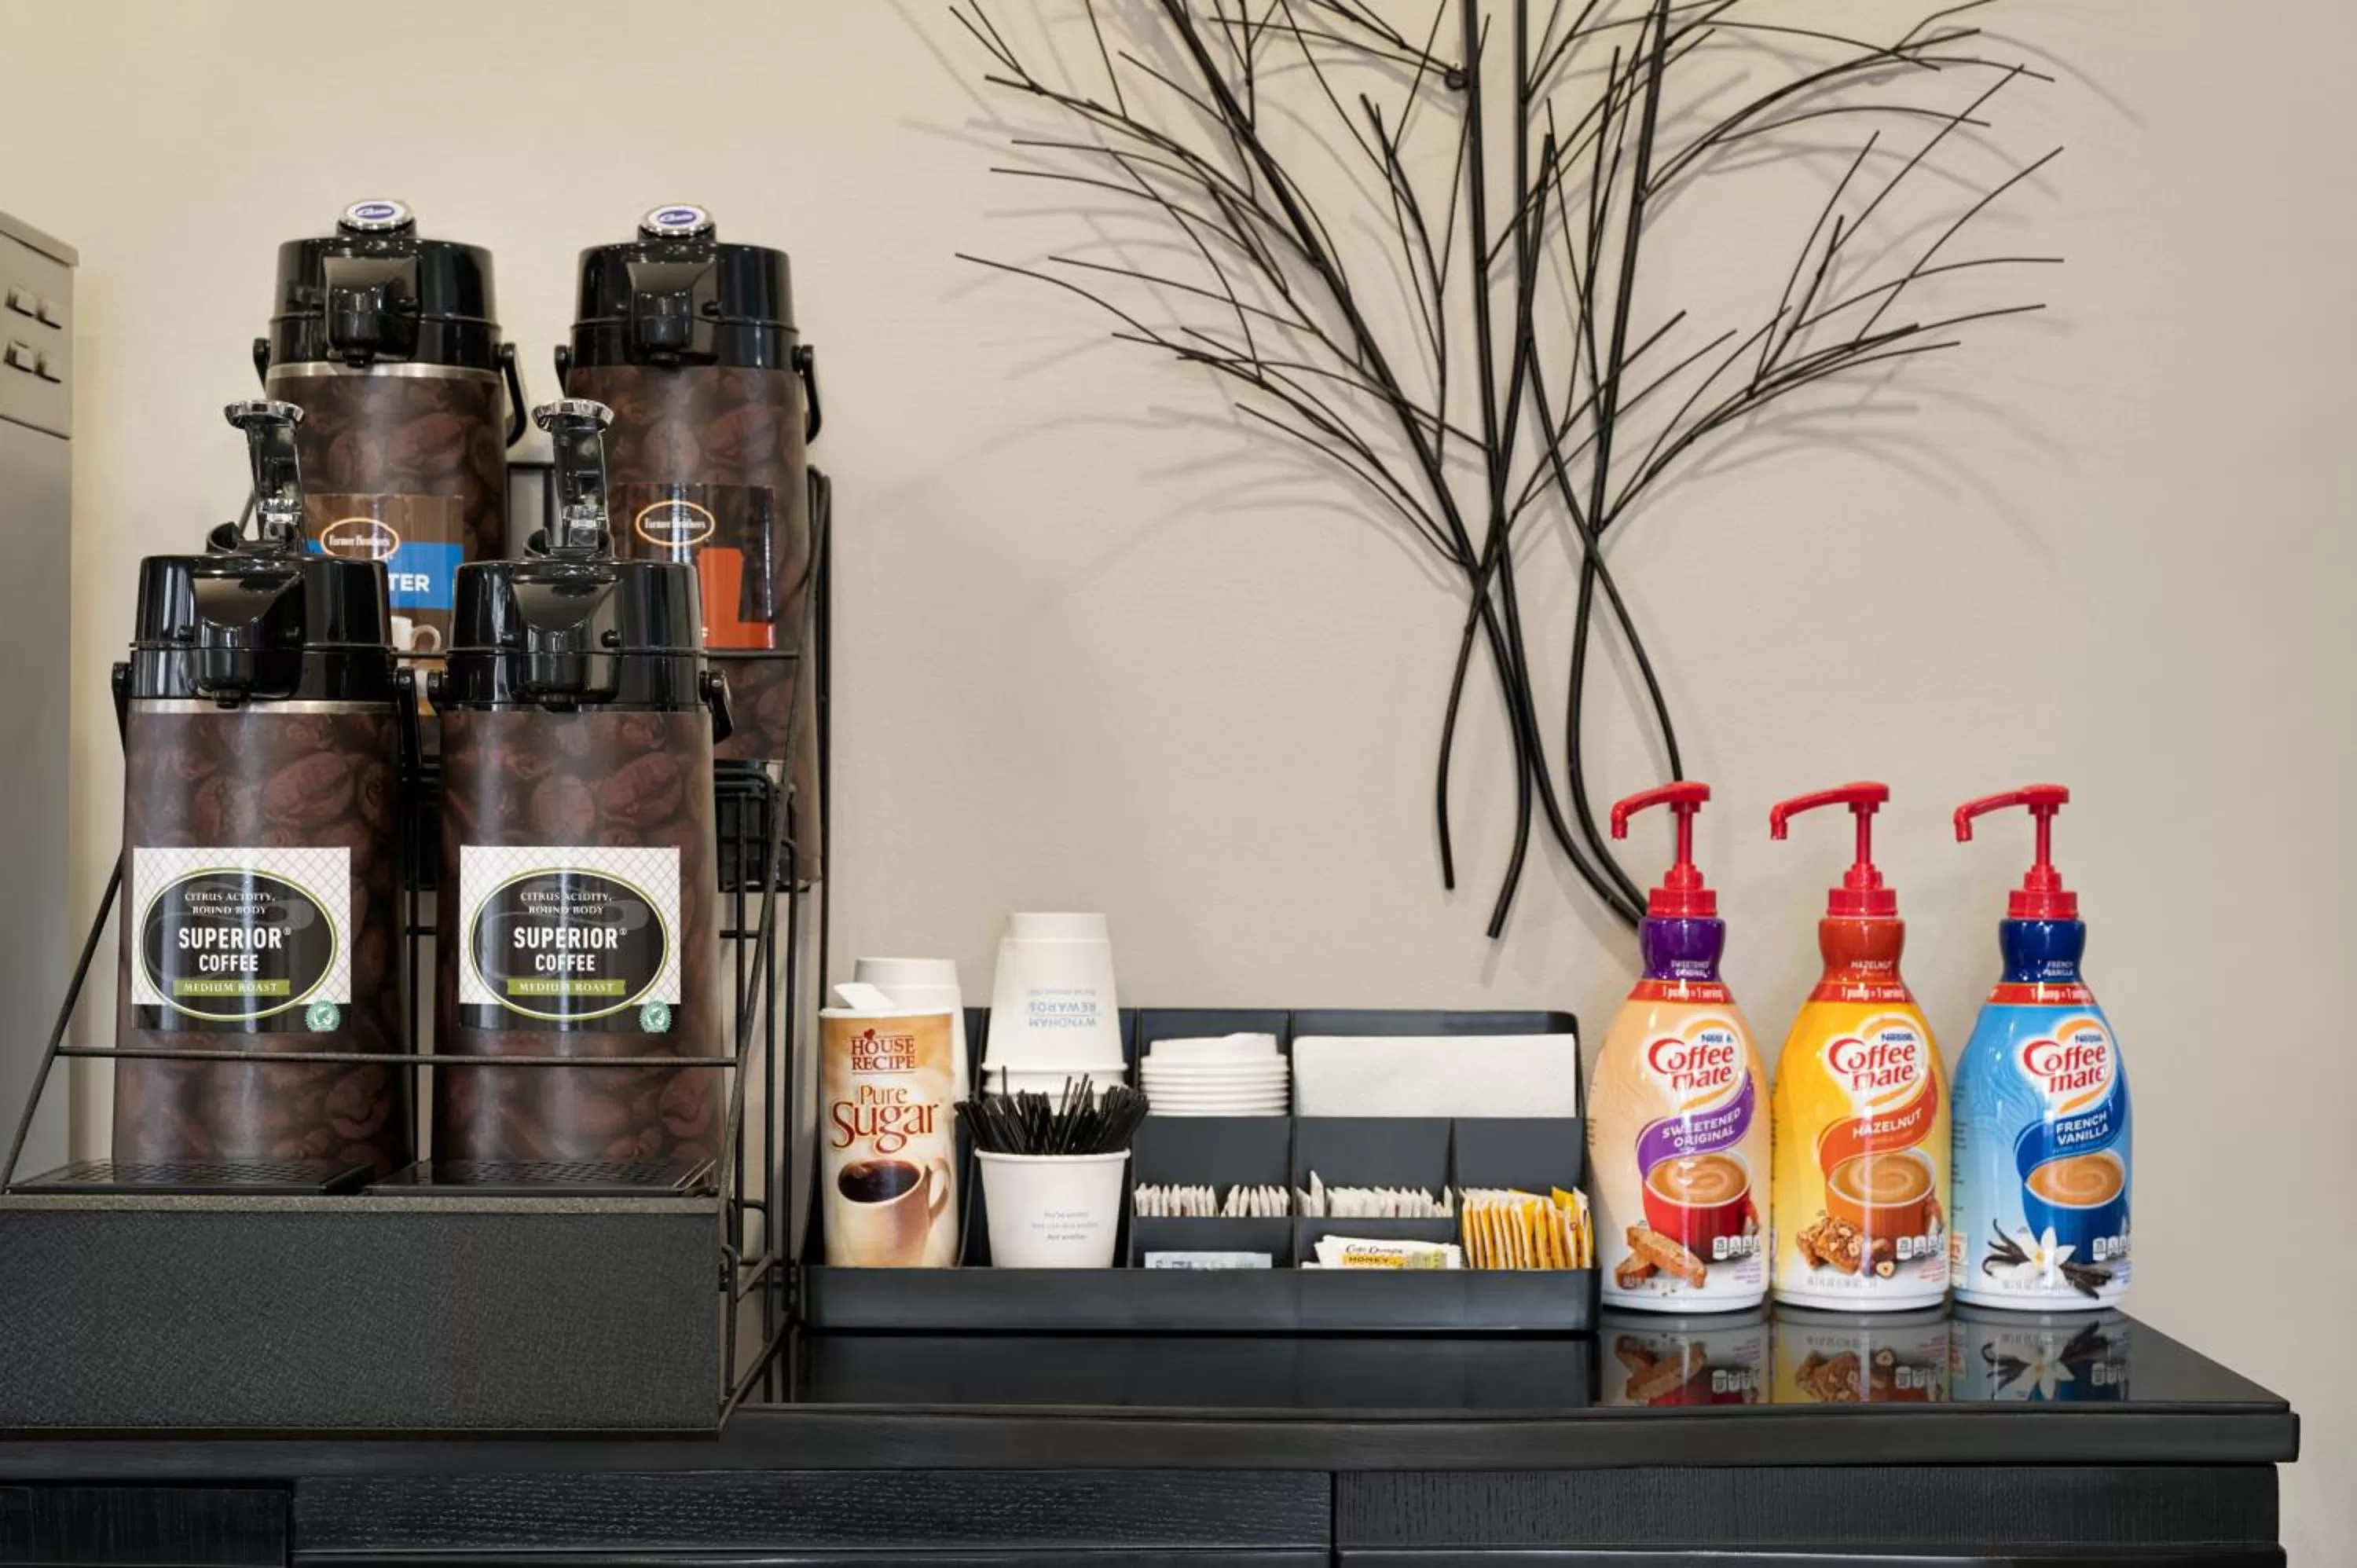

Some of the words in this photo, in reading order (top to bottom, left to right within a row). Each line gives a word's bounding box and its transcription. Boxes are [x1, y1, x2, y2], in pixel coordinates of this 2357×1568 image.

[388, 573, 431, 592] TER
[185, 892, 222, 902] CITRUS
[519, 892, 560, 902] CITRUS
[192, 906, 232, 915] ROUND
[236, 906, 267, 915] BODY
[529, 906, 568, 914] ROUND
[573, 906, 604, 914] BODY
[198, 954, 259, 972] COFFEE
[534, 954, 596, 972] COFFEE
[1850, 959, 1892, 969] HAZELNUT
[183, 982, 234, 992] MEDIUM
[237, 982, 277, 992] ROAST
[519, 982, 570, 992] MEDIUM
[574, 982, 615, 992] ROAST
[1029, 1002, 1097, 1013] REWARDS
[1028, 1018, 1097, 1028] WYNDHAM
[851, 1038, 915, 1055] HOUSE
[852, 1055, 915, 1071] RECIPE
[1648, 1038, 1734, 1075] Coffee
[1828, 1038, 1915, 1075] Coffee
[2023, 1040, 2106, 1076] Coffee
[1672, 1066, 1732, 1091] mate
[1851, 1064, 1914, 1091] mate
[2048, 1067, 2106, 1093] mate
[860, 1085, 908, 1105] Pure
[831, 1101, 940, 1154] Sugar
[1662, 1107, 1742, 1139] SWEETENED
[1852, 1107, 1923, 1138] HAZELNUT
[2055, 1110, 2107, 1134] FRENCH
[1673, 1125, 1736, 1148] ORIGINAL
[2057, 1123, 2110, 1146] VANILLA
